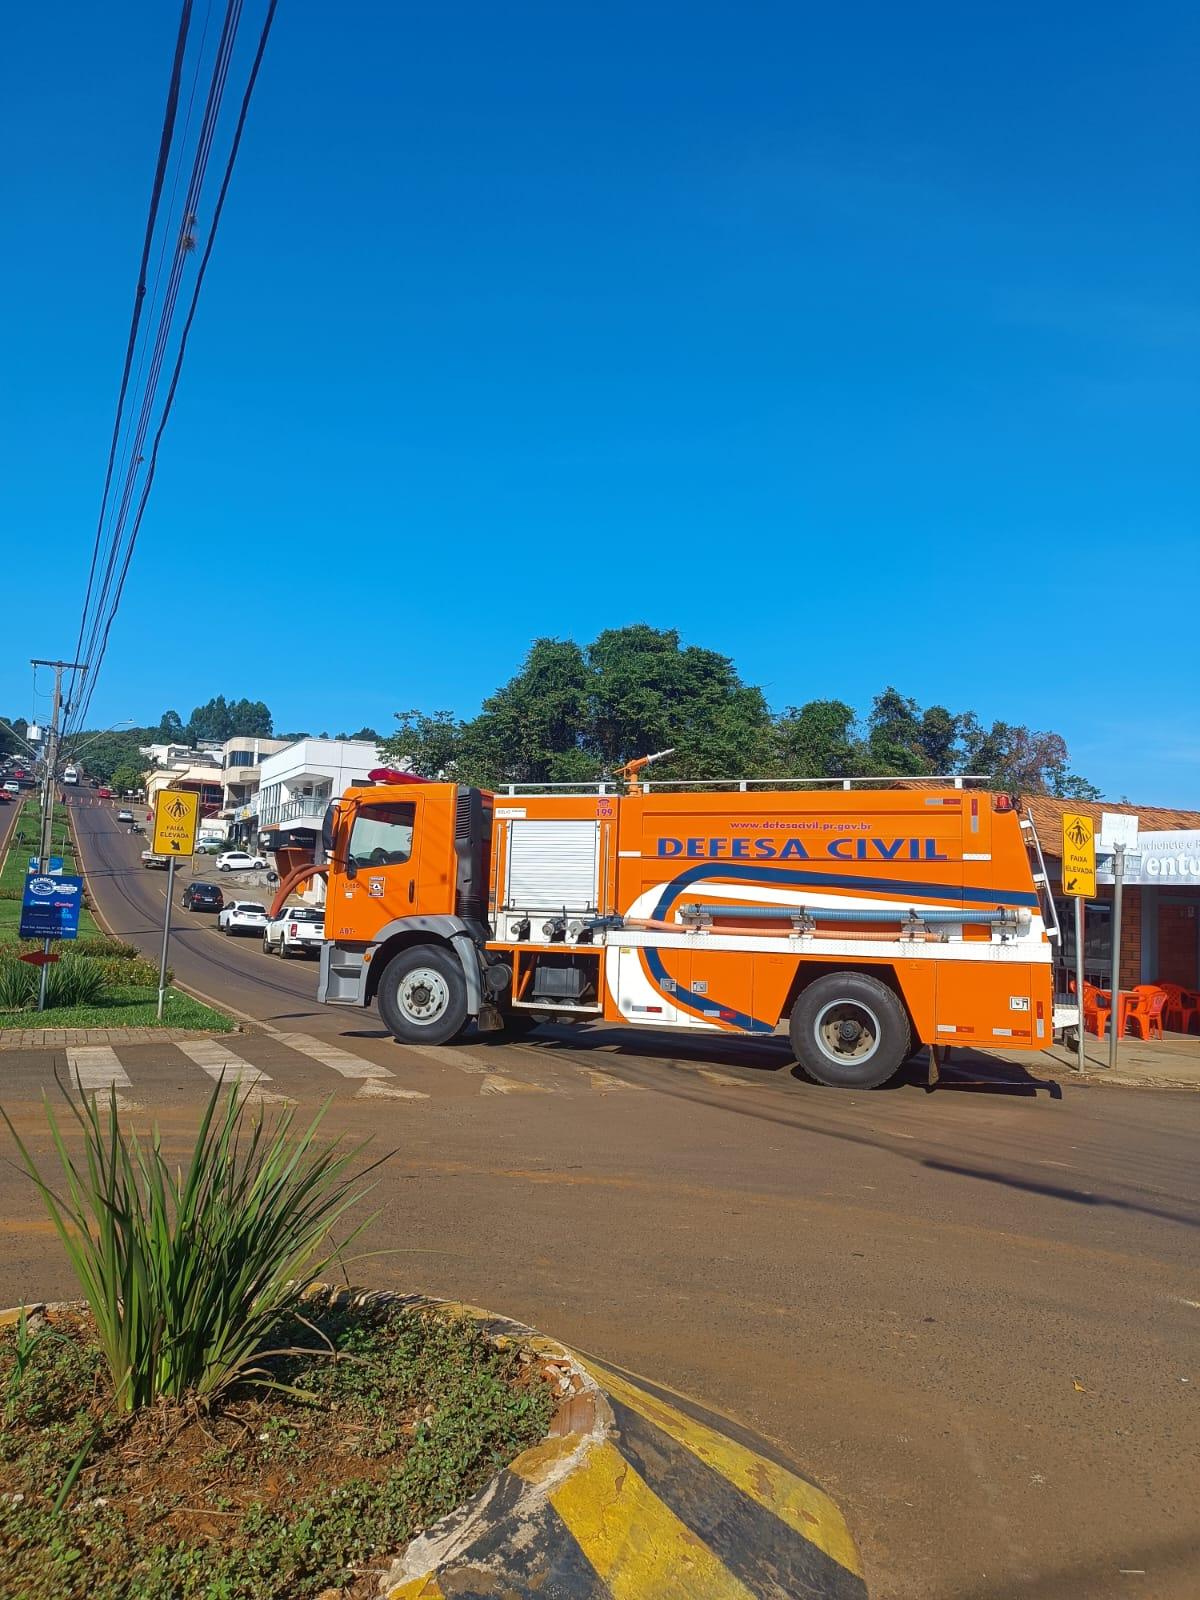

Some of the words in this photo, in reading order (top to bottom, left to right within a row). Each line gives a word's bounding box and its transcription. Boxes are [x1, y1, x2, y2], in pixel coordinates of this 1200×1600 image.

[595, 808, 613, 817] 199
[730, 821, 872, 831] www.defesacivil.pr.gov.br
[160, 831, 189, 839] ELEVADA
[657, 837, 810, 859] DEFESA
[826, 838, 948, 860] CIVIL
[1140, 839, 1185, 850] nchonete
[1070, 854, 1088, 863] FAIXA
[1065, 864, 1094, 875] ELEVADA
